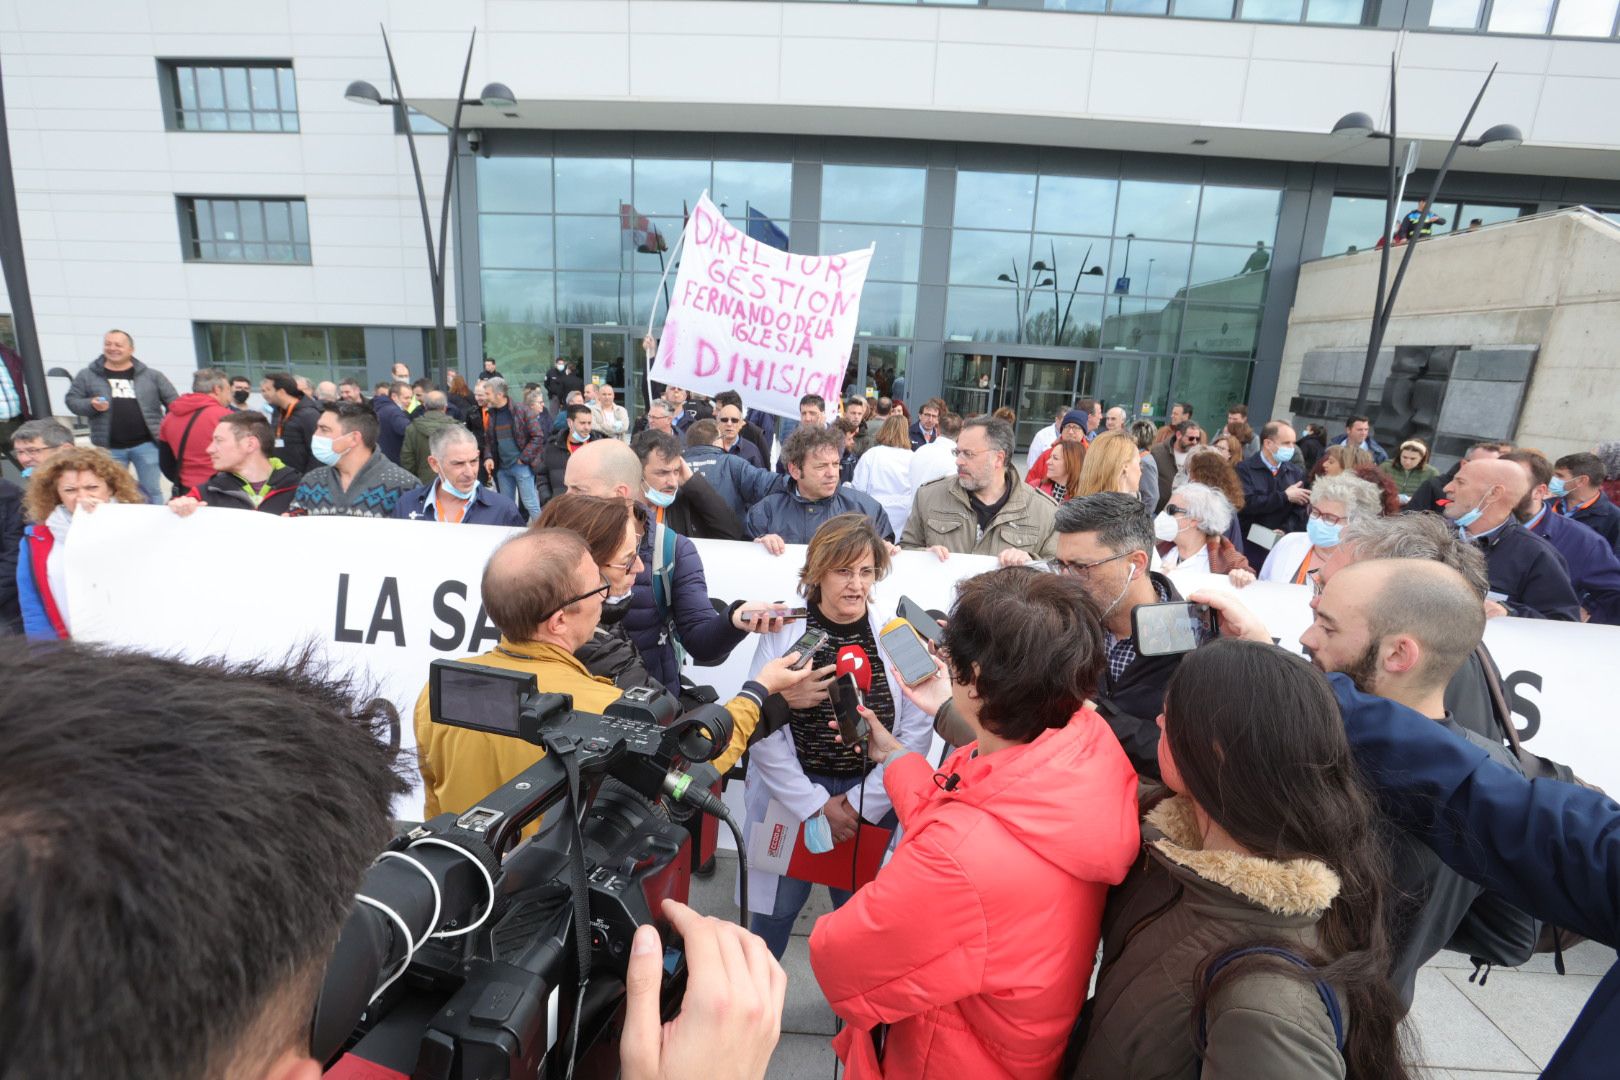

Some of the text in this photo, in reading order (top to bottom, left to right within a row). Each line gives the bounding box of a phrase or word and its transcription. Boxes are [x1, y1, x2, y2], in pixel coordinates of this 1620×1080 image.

[683, 280, 791, 331] FERNANDO
[732, 321, 814, 358] IGLESIA
[335, 573, 406, 647] LA
